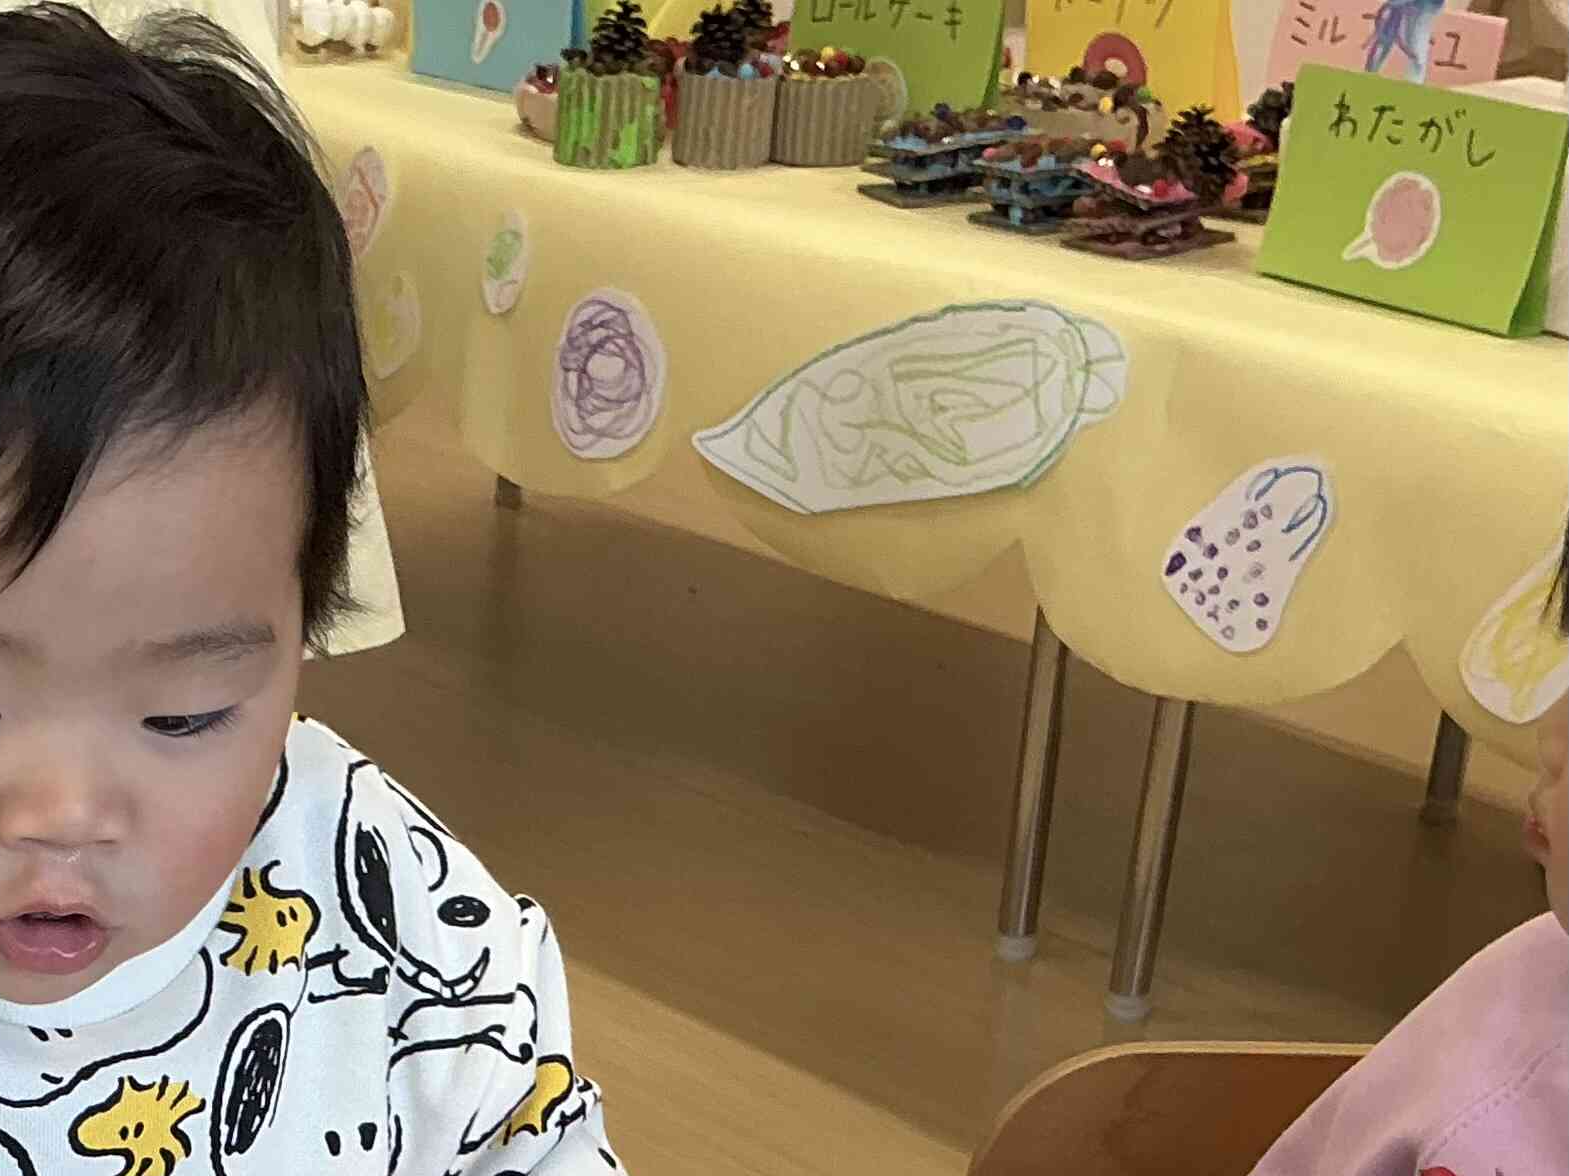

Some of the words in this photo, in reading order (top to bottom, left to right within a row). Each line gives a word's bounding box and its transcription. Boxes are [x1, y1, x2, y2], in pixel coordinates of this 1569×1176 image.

[1291, 1, 1468, 70] ミルユ
[1328, 90, 1496, 167] わたがし
